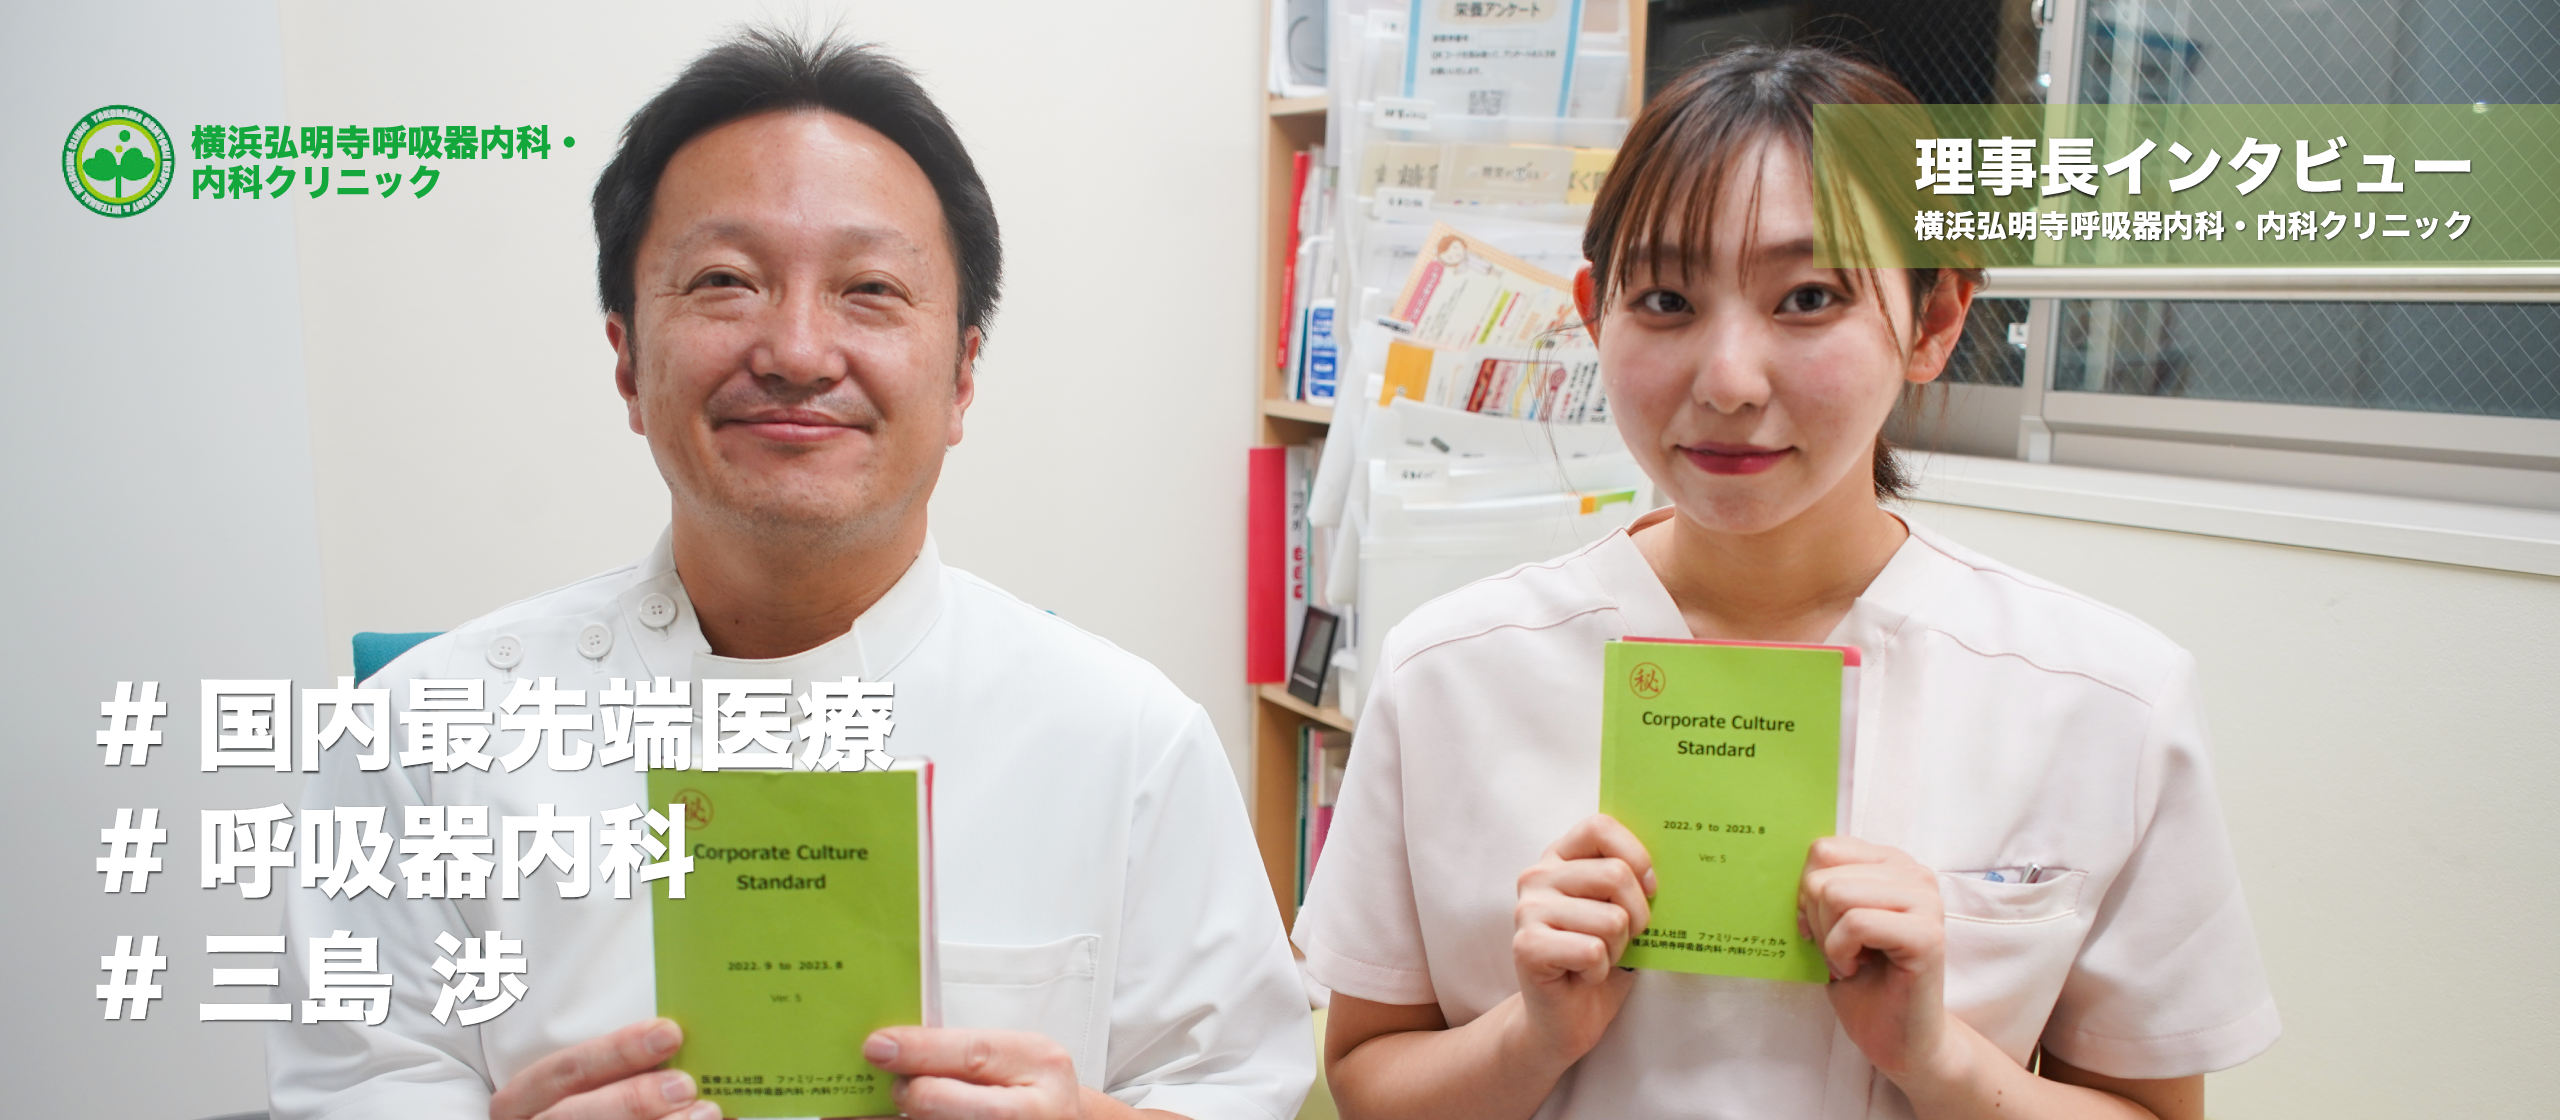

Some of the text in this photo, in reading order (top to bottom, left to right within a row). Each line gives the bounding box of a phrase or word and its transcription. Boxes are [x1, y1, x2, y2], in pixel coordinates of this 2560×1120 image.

[1453, 1, 1541, 18] 栄養アンケート
[1641, 710, 1796, 733] Corporate Culture
[1676, 739, 1757, 759] Standard
[1708, 823, 1720, 832] to
[694, 843, 869, 864] Corporate Culture
[736, 874, 827, 890] Standard
[1641, 927, 1788, 947] 療法人社団 ファミリーメディカル
